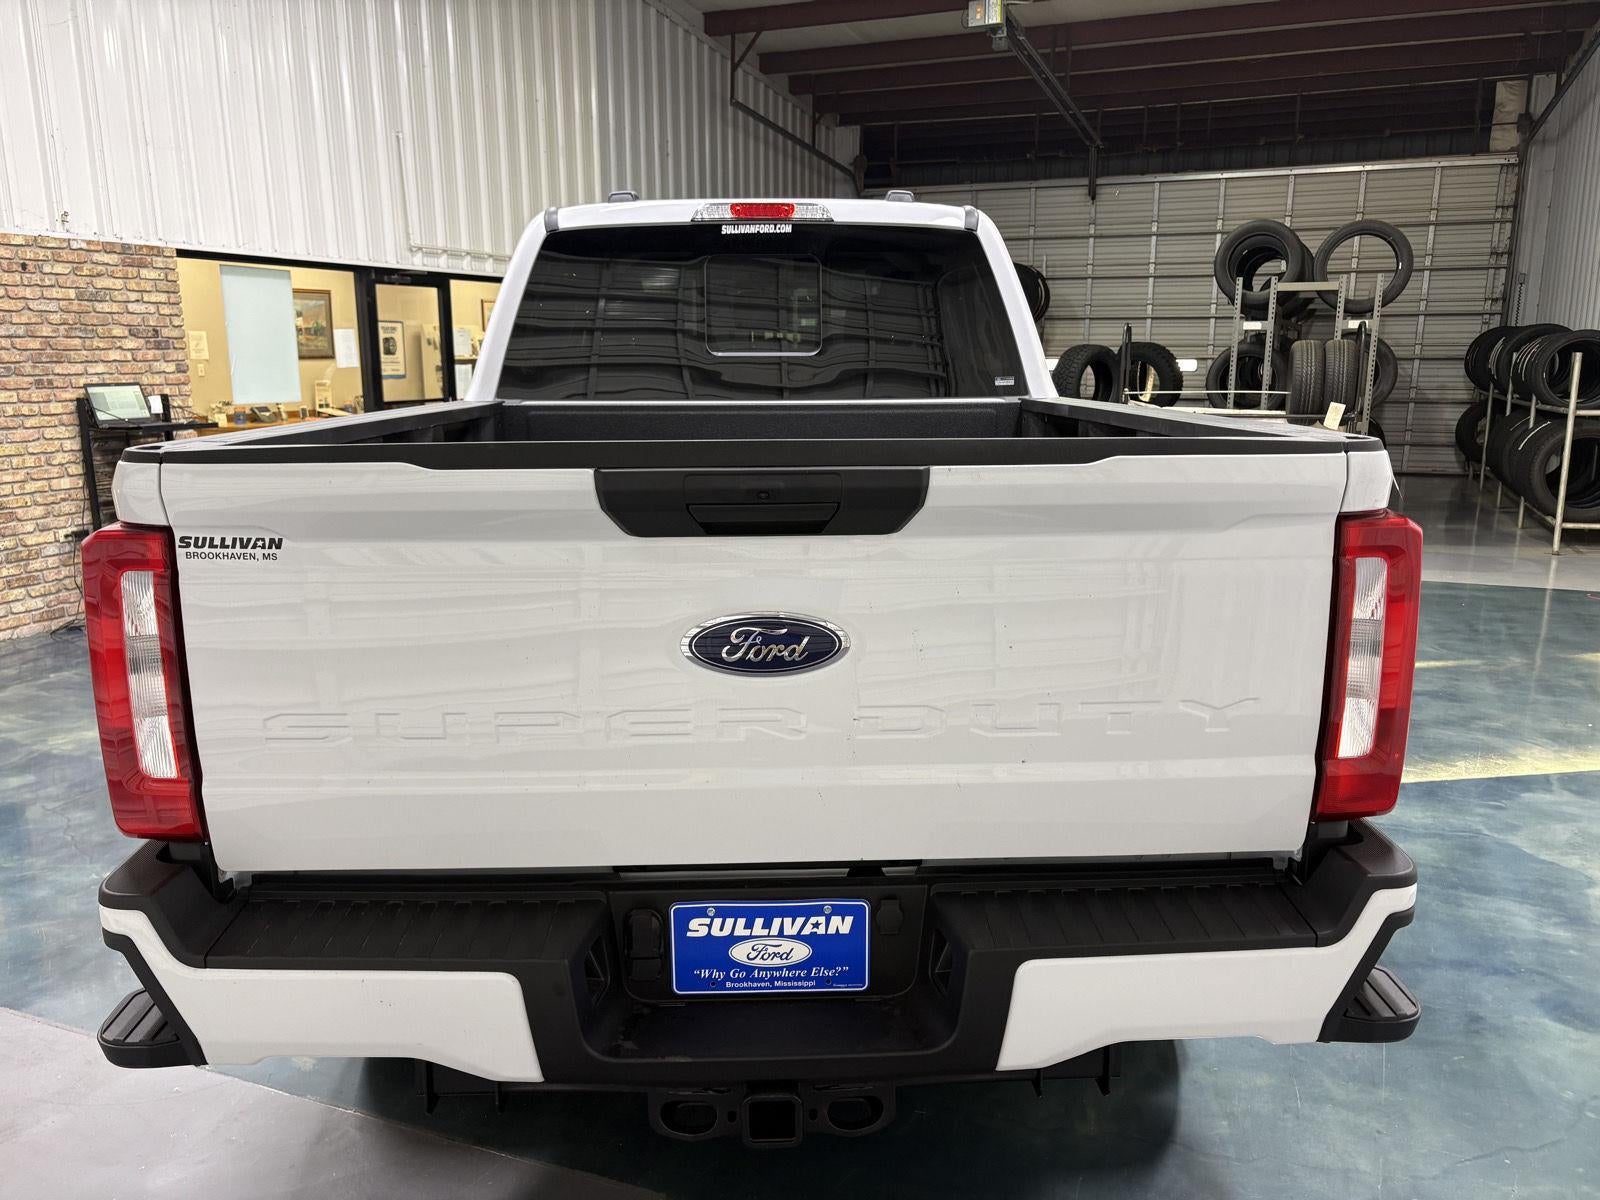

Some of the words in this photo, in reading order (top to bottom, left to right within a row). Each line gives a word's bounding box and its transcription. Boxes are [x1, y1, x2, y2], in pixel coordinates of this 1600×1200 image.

[721, 224, 793, 234] SULLIVANFORD.COM
[178, 536, 283, 550] SULLIVAN
[185, 552, 259, 561] BROOKHAVEN,
[262, 553, 278, 561] MS
[721, 626, 809, 662] Ford
[263, 706, 808, 747] SUPER
[855, 697, 1260, 741] DUTY
[686, 915, 854, 938] SULLIVAN
[746, 942, 794, 962] Ford
[729, 968, 746, 979] Go
[750, 966, 808, 980] Anywhere
[725, 980, 773, 988] Brookhaven,
[774, 980, 816, 989] Mississippi
